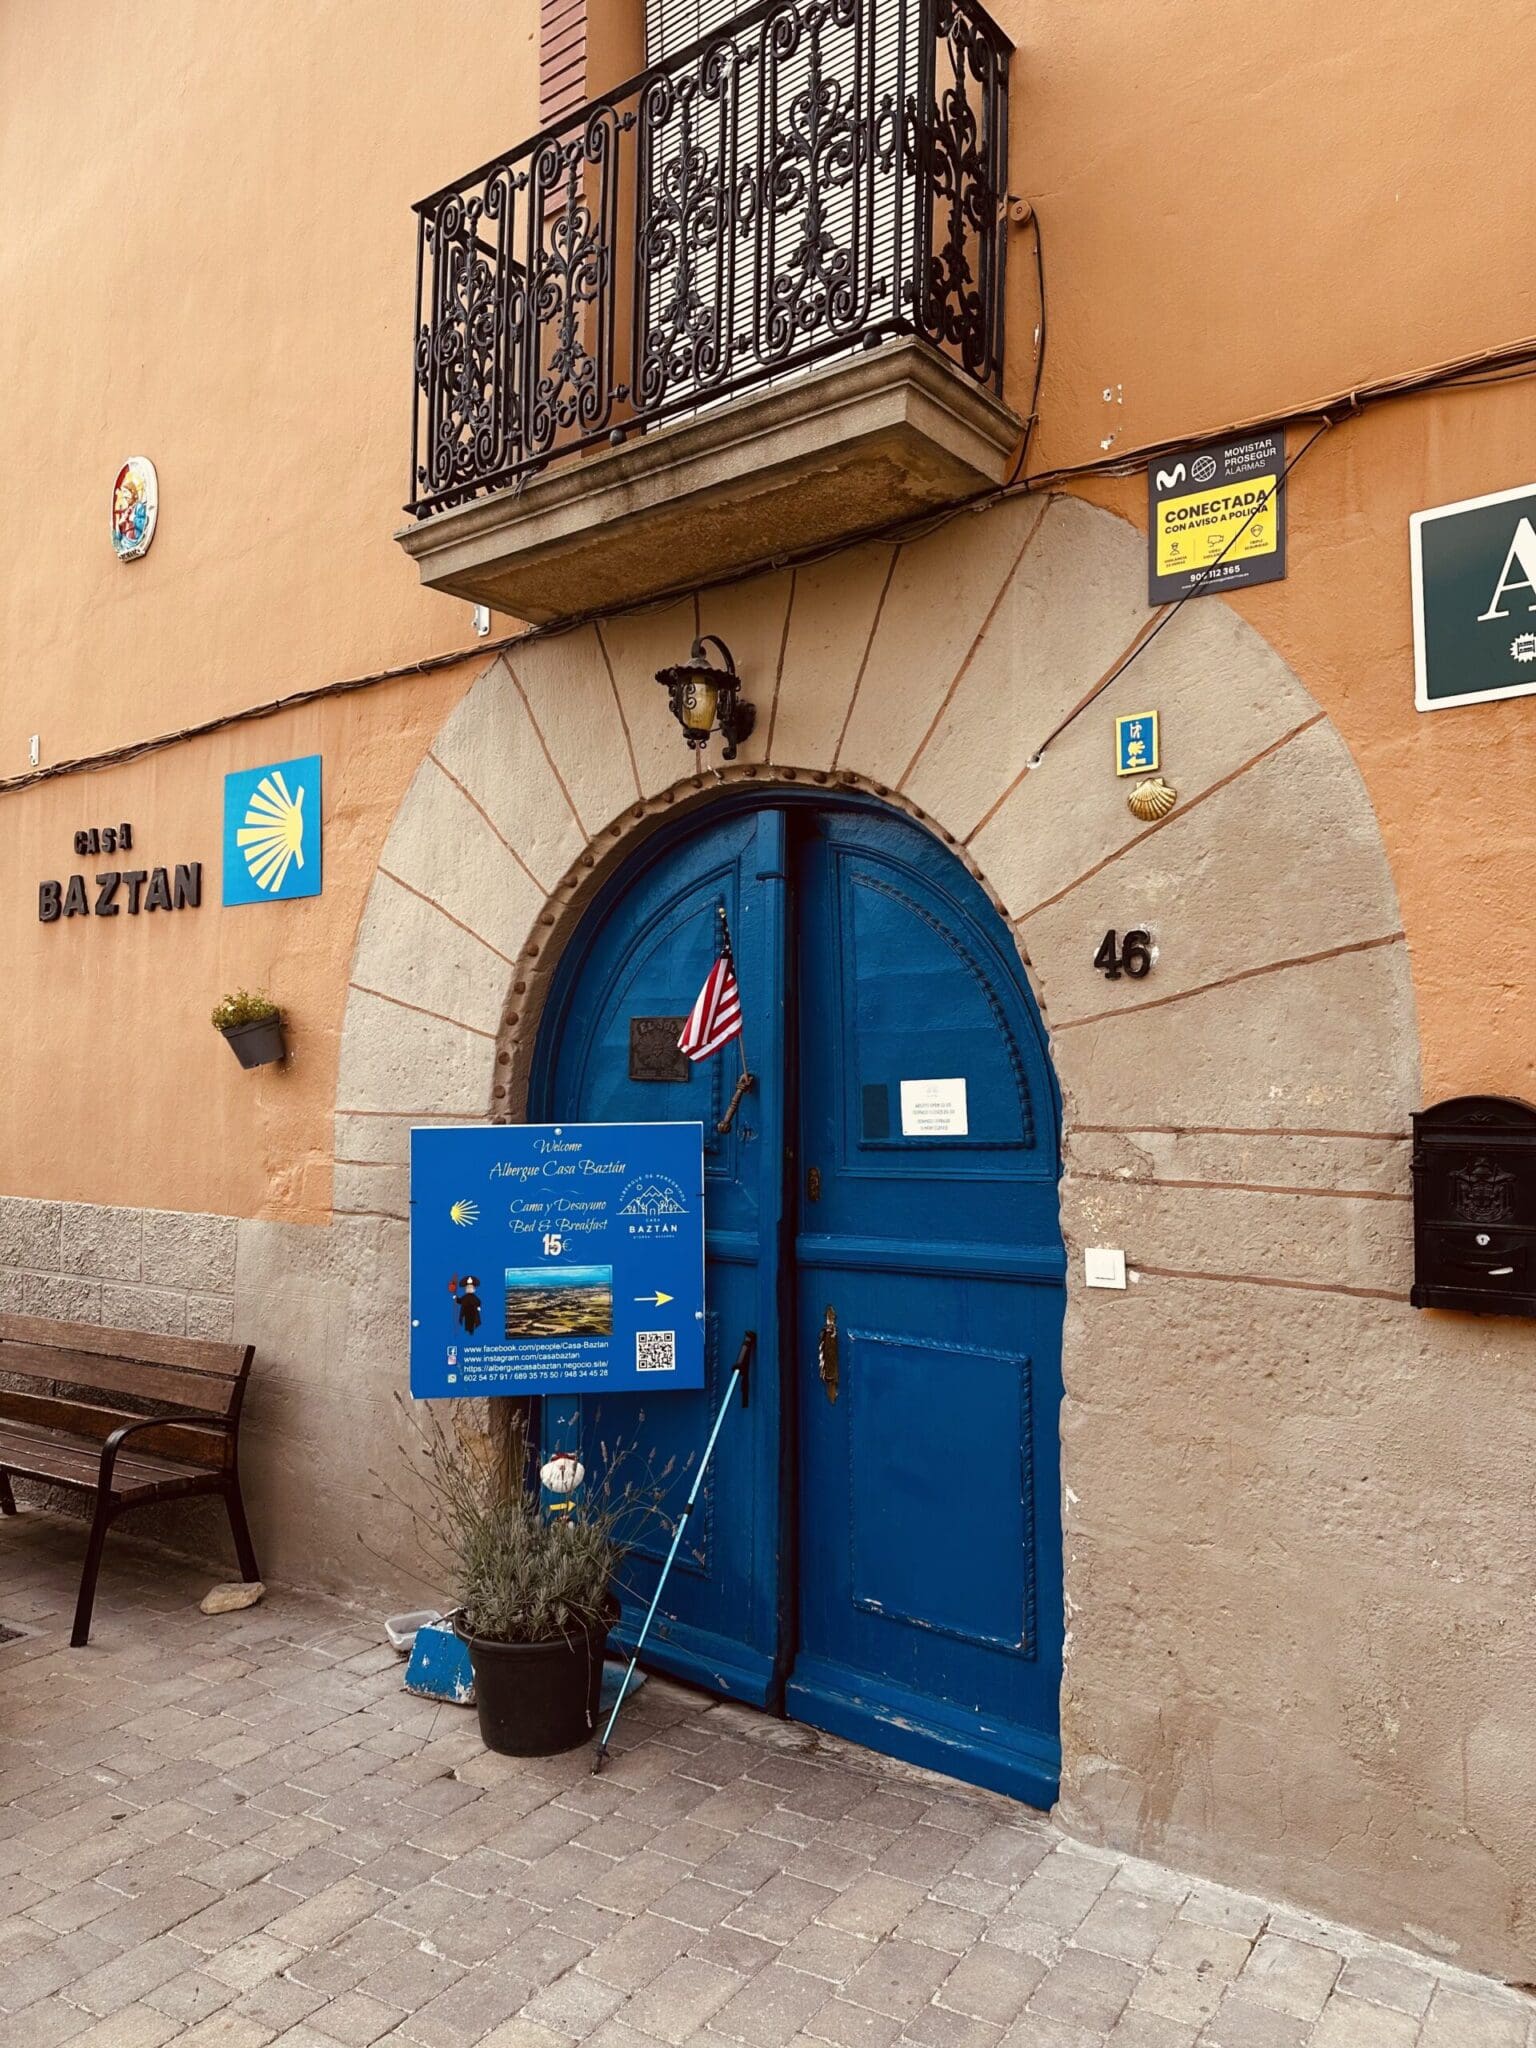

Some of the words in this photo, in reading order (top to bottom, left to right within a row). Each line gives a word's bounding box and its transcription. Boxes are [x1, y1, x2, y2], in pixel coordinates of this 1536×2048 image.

[1224, 439, 1272, 458] MOVISTAR
[1224, 447, 1277, 468] PROSEGUR
[1224, 460, 1266, 477] ALARMAS
[1165, 489, 1267, 523] CONECTADA
[1165, 522, 1186, 535] CON
[1188, 515, 1218, 529] AVISO
[1220, 513, 1227, 522] A
[1209, 569, 1221, 578] 112
[1223, 565, 1241, 576] 365
[1477, 517, 1536, 622] A
[73, 822, 132, 855] CASA
[39, 861, 201, 922] BAZTAN
[1093, 929, 1151, 980] 46
[533, 1139, 582, 1154] Welcome
[489, 1161, 540, 1182] Albergue
[542, 1160, 576, 1177] Casa
[578, 1159, 626, 1176] Baztán
[510, 1199, 543, 1213] Cama
[546, 1203, 553, 1217] y
[553, 1198, 606, 1216] Desayuno
[508, 1219, 537, 1233] Bed
[538, 1219, 551, 1232] &
[555, 1217, 608, 1233] Breakfast
[629, 1223, 678, 1234] BAZTÁN
[542, 1233, 573, 1256] 15€
[464, 1373, 477, 1382] 602
[589, 1369, 598, 1377] 45
